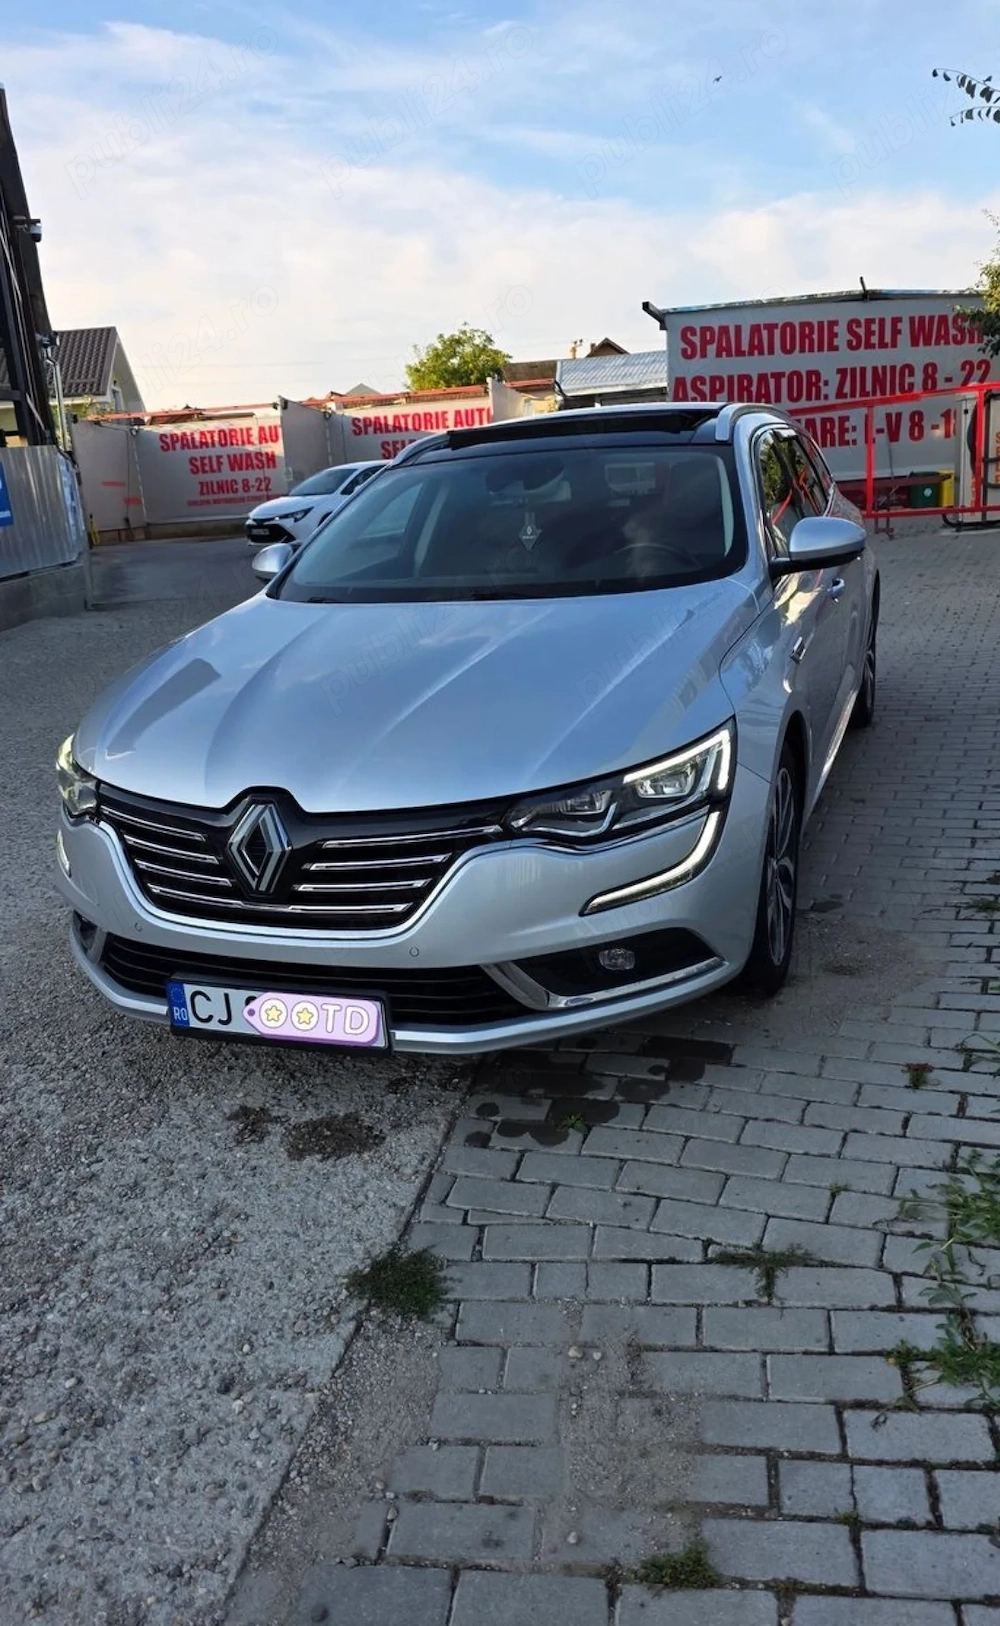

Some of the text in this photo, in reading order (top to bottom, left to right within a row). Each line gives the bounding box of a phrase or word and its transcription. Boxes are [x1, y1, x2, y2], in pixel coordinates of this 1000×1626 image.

[680, 319, 839, 360] SPALATORIE
[846, 316, 903, 350] SELF
[672, 369, 829, 404] ASPIRATOR:
[835, 363, 915, 399] ZILNIC
[922, 361, 938, 391] 8
[960, 359, 991, 387] 22
[351, 411, 449, 436] SPALATORIE
[795, 416, 857, 449] ARE:
[908, 410, 925, 442] 8
[931, 408, 957, 439] -1
[159, 428, 254, 452] SPALATORIE
[189, 451, 277, 475] SELF WASH
[198, 476, 272, 496] ZILNIC 8-22
[174, 1006, 188, 1021] RO
[189, 990, 232, 1026] CJ
